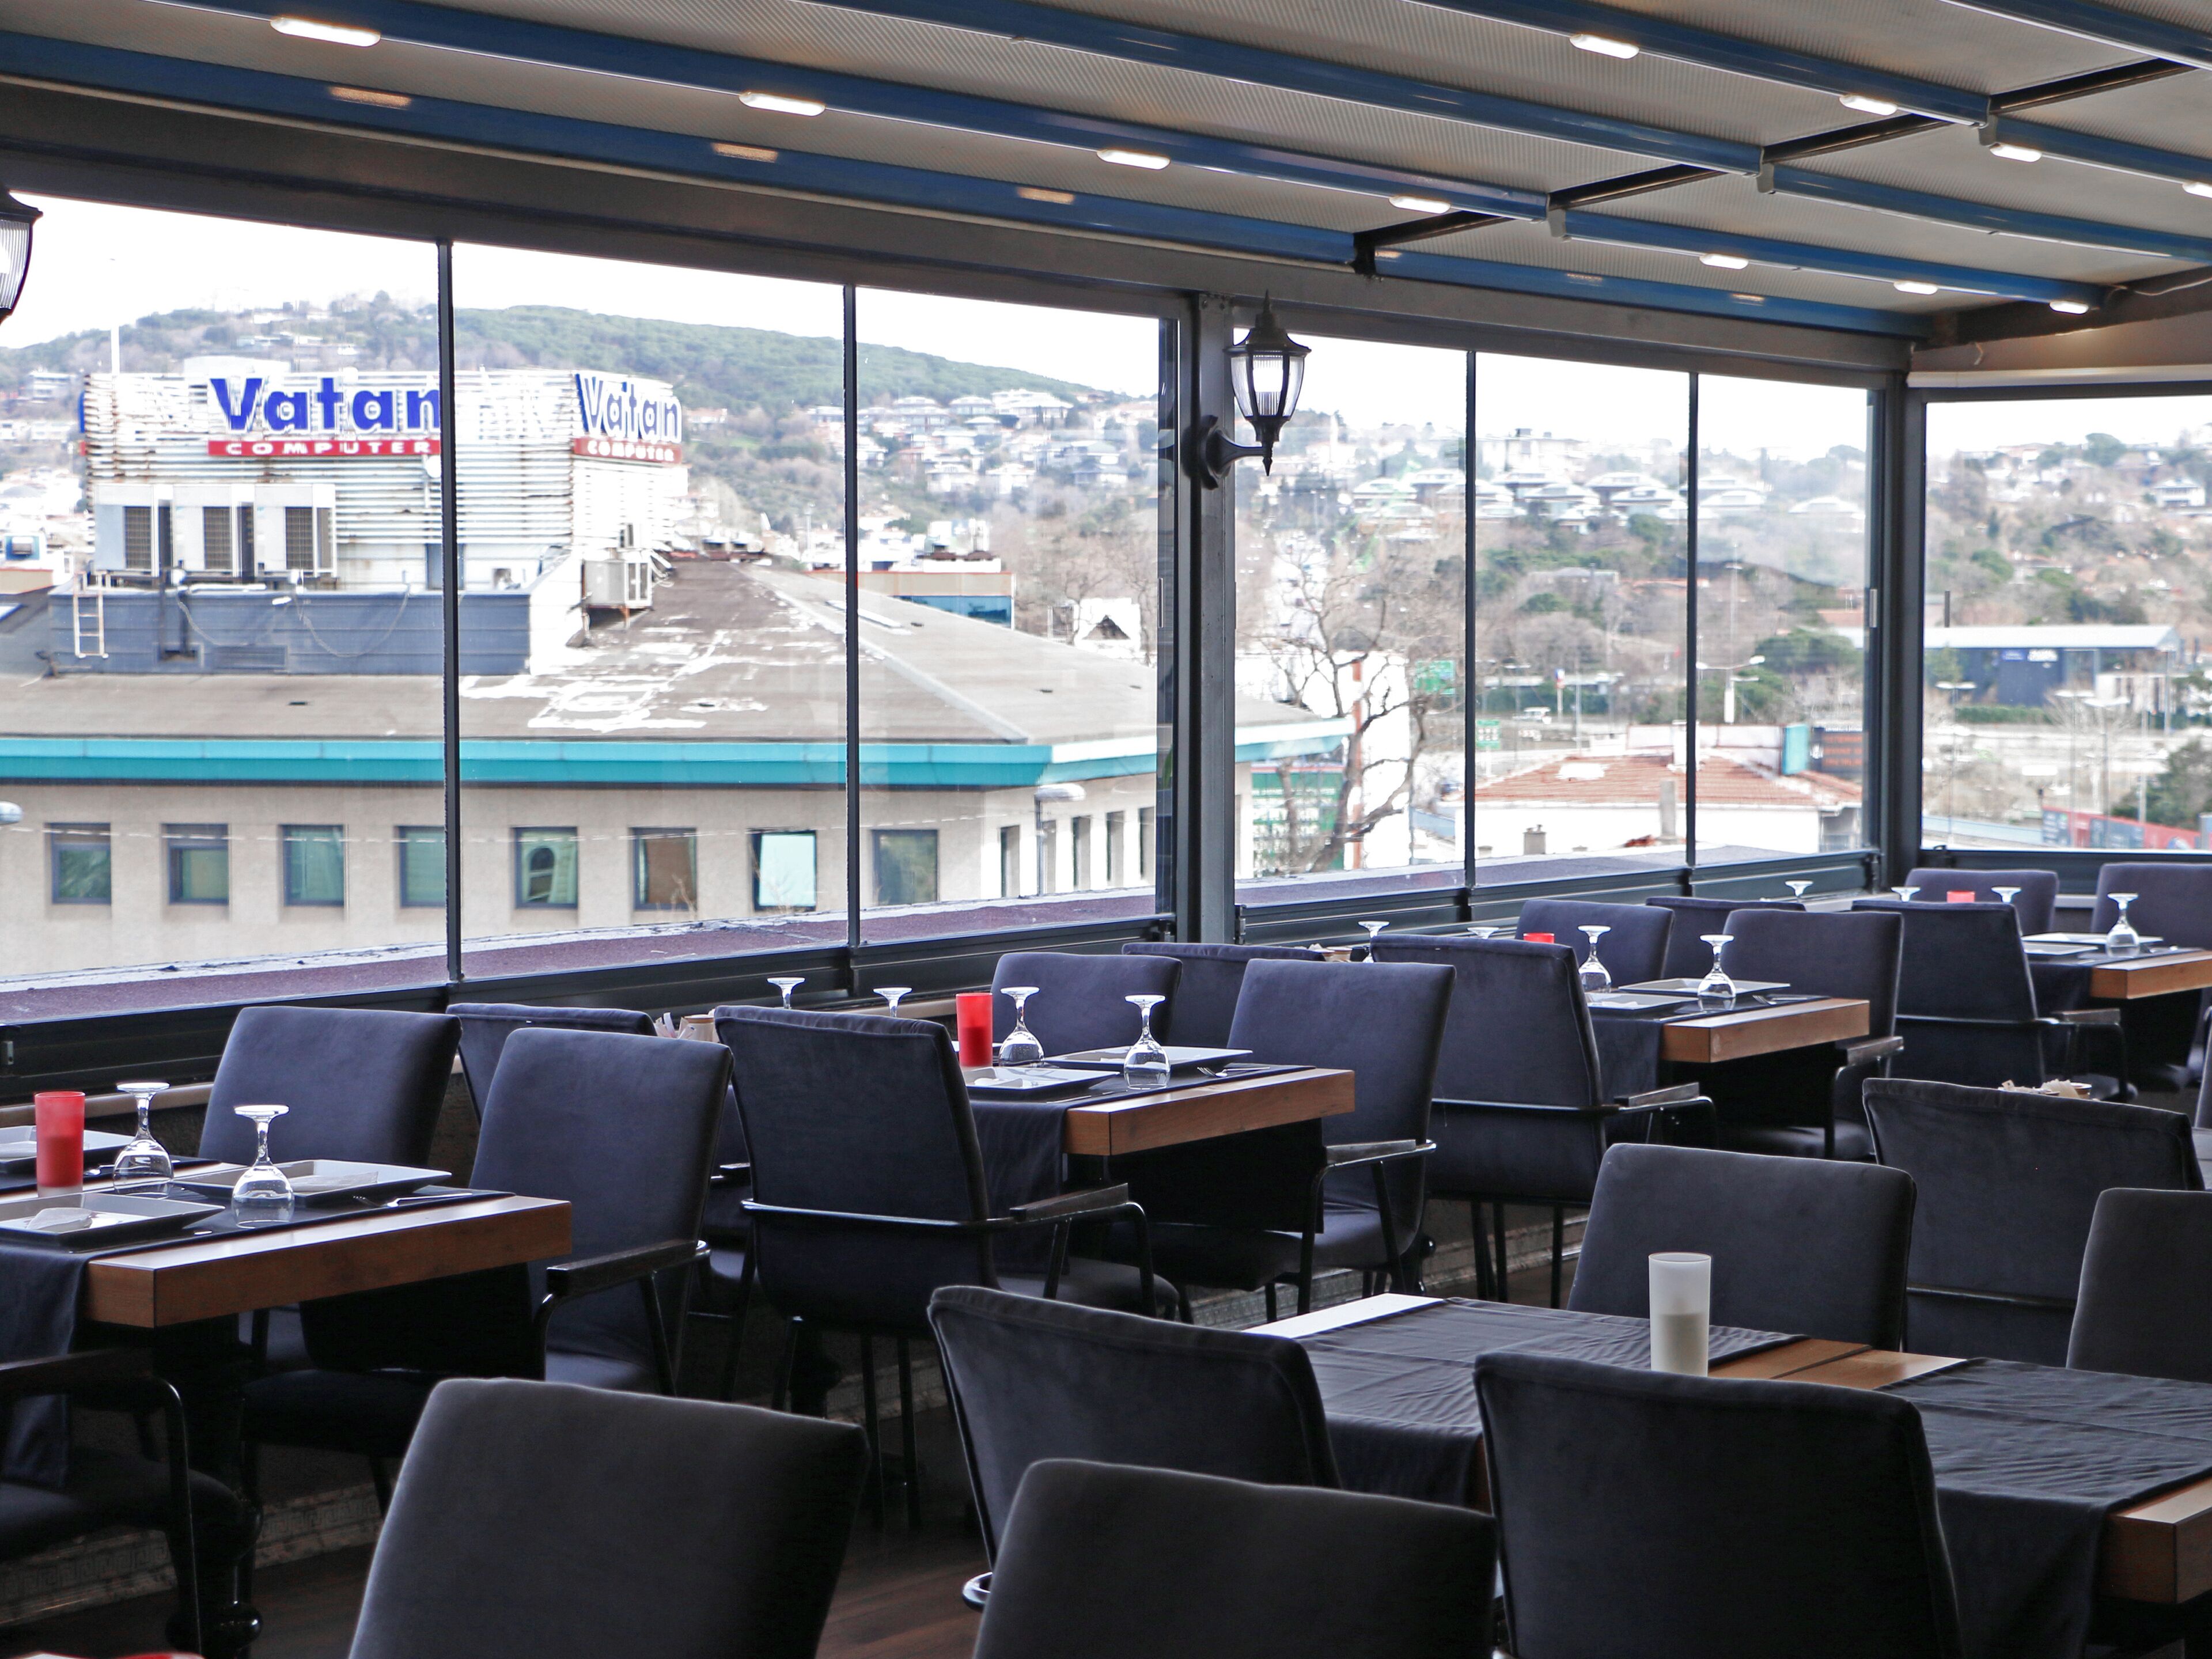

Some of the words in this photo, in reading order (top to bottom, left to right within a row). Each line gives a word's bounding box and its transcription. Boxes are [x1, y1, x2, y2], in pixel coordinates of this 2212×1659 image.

[210, 377, 440, 430] Vatan
[578, 374, 681, 442] Vatan
[225, 441, 431, 454] COMPUTER
[588, 440, 675, 462] COMPUTER
